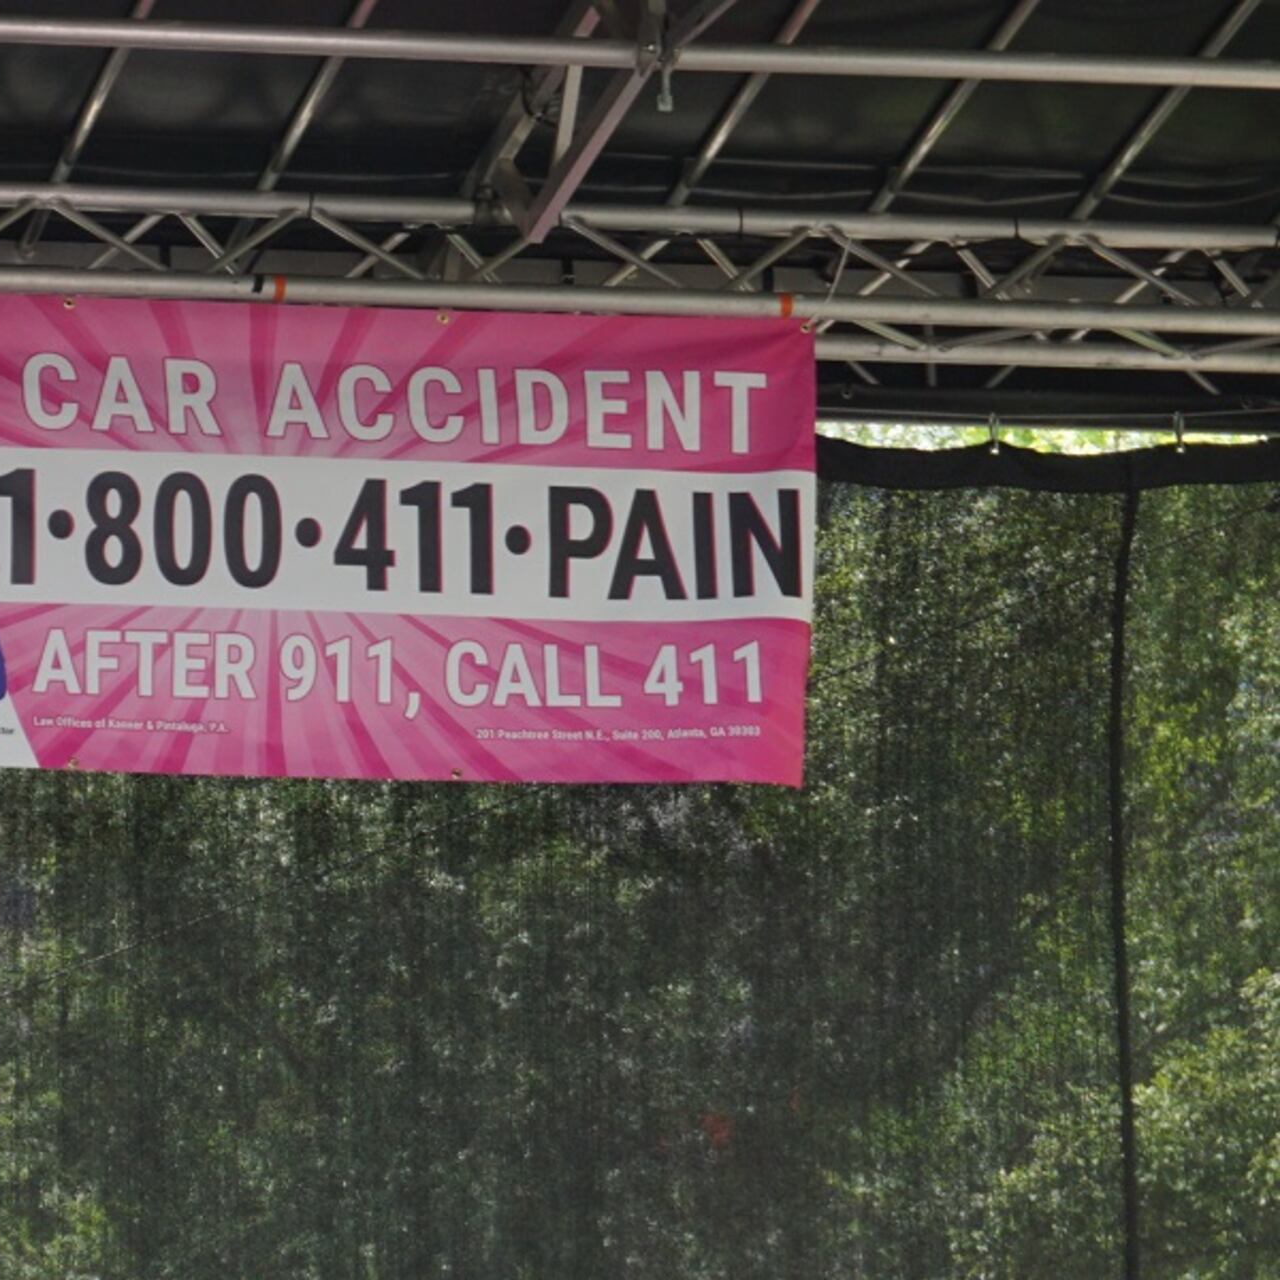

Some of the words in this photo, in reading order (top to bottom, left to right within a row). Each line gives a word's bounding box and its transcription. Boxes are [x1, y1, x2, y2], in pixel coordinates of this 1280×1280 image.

[20, 352, 223, 438] CAR
[265, 361, 768, 455] ACCIDENT
[33, 629, 259, 701] AFTER
[280, 635, 422, 719] 911,
[446, 638, 622, 708] CALL
[642, 640, 763, 705] 411
[33, 716, 55, 727] Law
[56, 717, 92, 728] Offices
[94, 718, 106, 729] of
[497, 729, 549, 740] Peachtree
[552, 729, 583, 740] Street
[611, 729, 639, 741] Suite
[710, 726, 726, 738] GA
